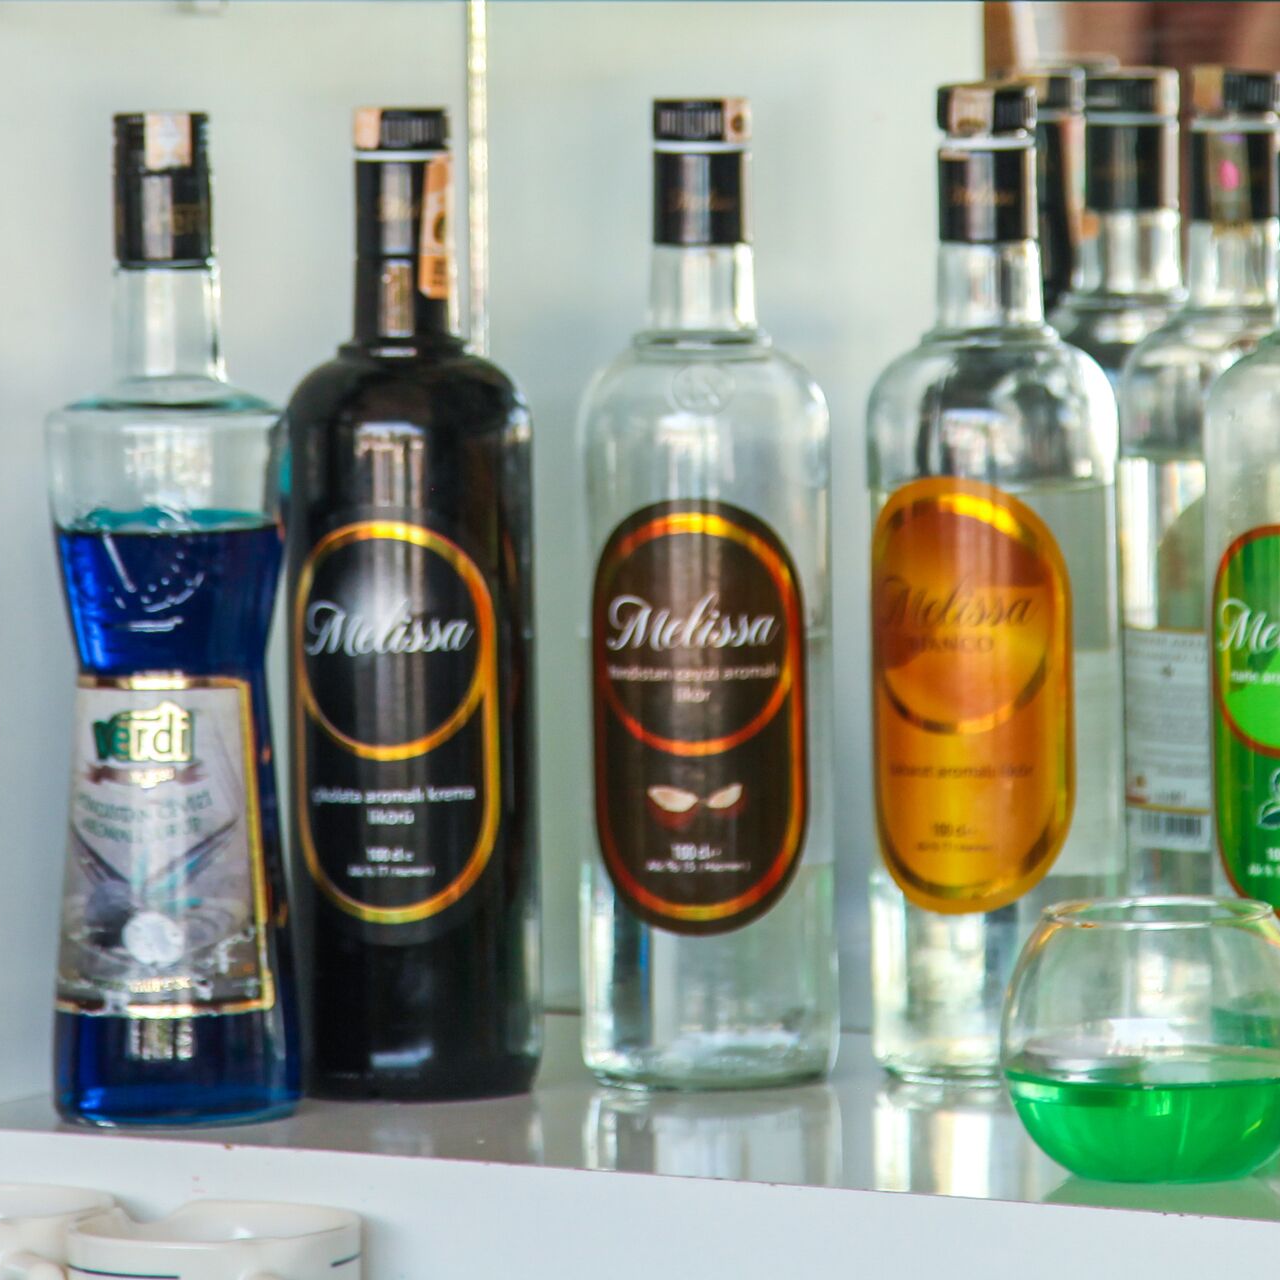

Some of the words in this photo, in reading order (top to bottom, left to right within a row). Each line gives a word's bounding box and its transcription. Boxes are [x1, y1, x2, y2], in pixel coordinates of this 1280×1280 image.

[305, 598, 474, 656] Melissa
[606, 590, 780, 651] Melissa
[878, 575, 1041, 629] Melissa
[426, 784, 476, 802] krema
